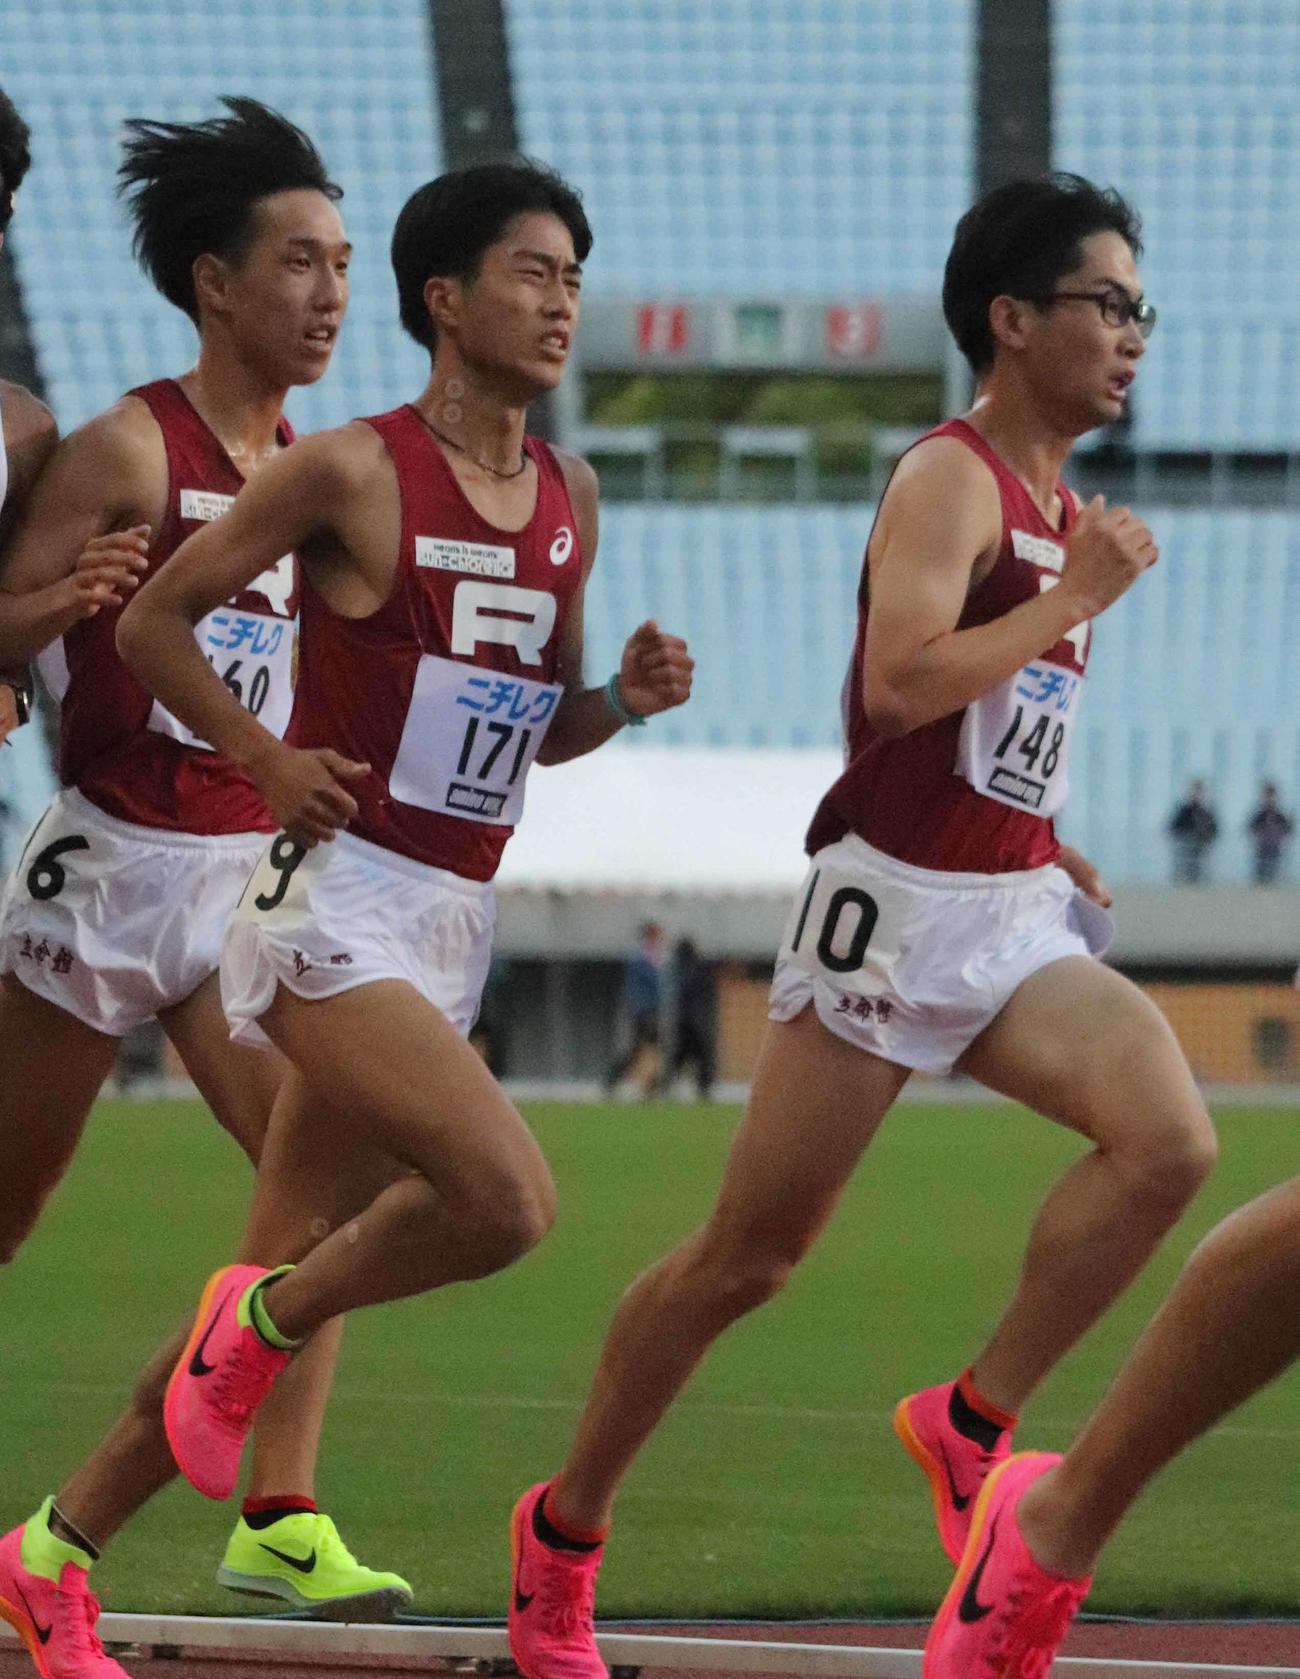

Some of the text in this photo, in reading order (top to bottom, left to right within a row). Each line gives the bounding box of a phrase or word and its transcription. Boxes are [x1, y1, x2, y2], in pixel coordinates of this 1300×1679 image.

[451, 580, 557, 666] R
[208, 654, 270, 707] 60
[456, 678, 557, 723] ニチレク
[456, 716, 531, 786] 171
[994, 705, 1065, 779] 148
[17, 806, 91, 901] 6
[236, 832, 309, 911] 9
[791, 868, 879, 973] 10
